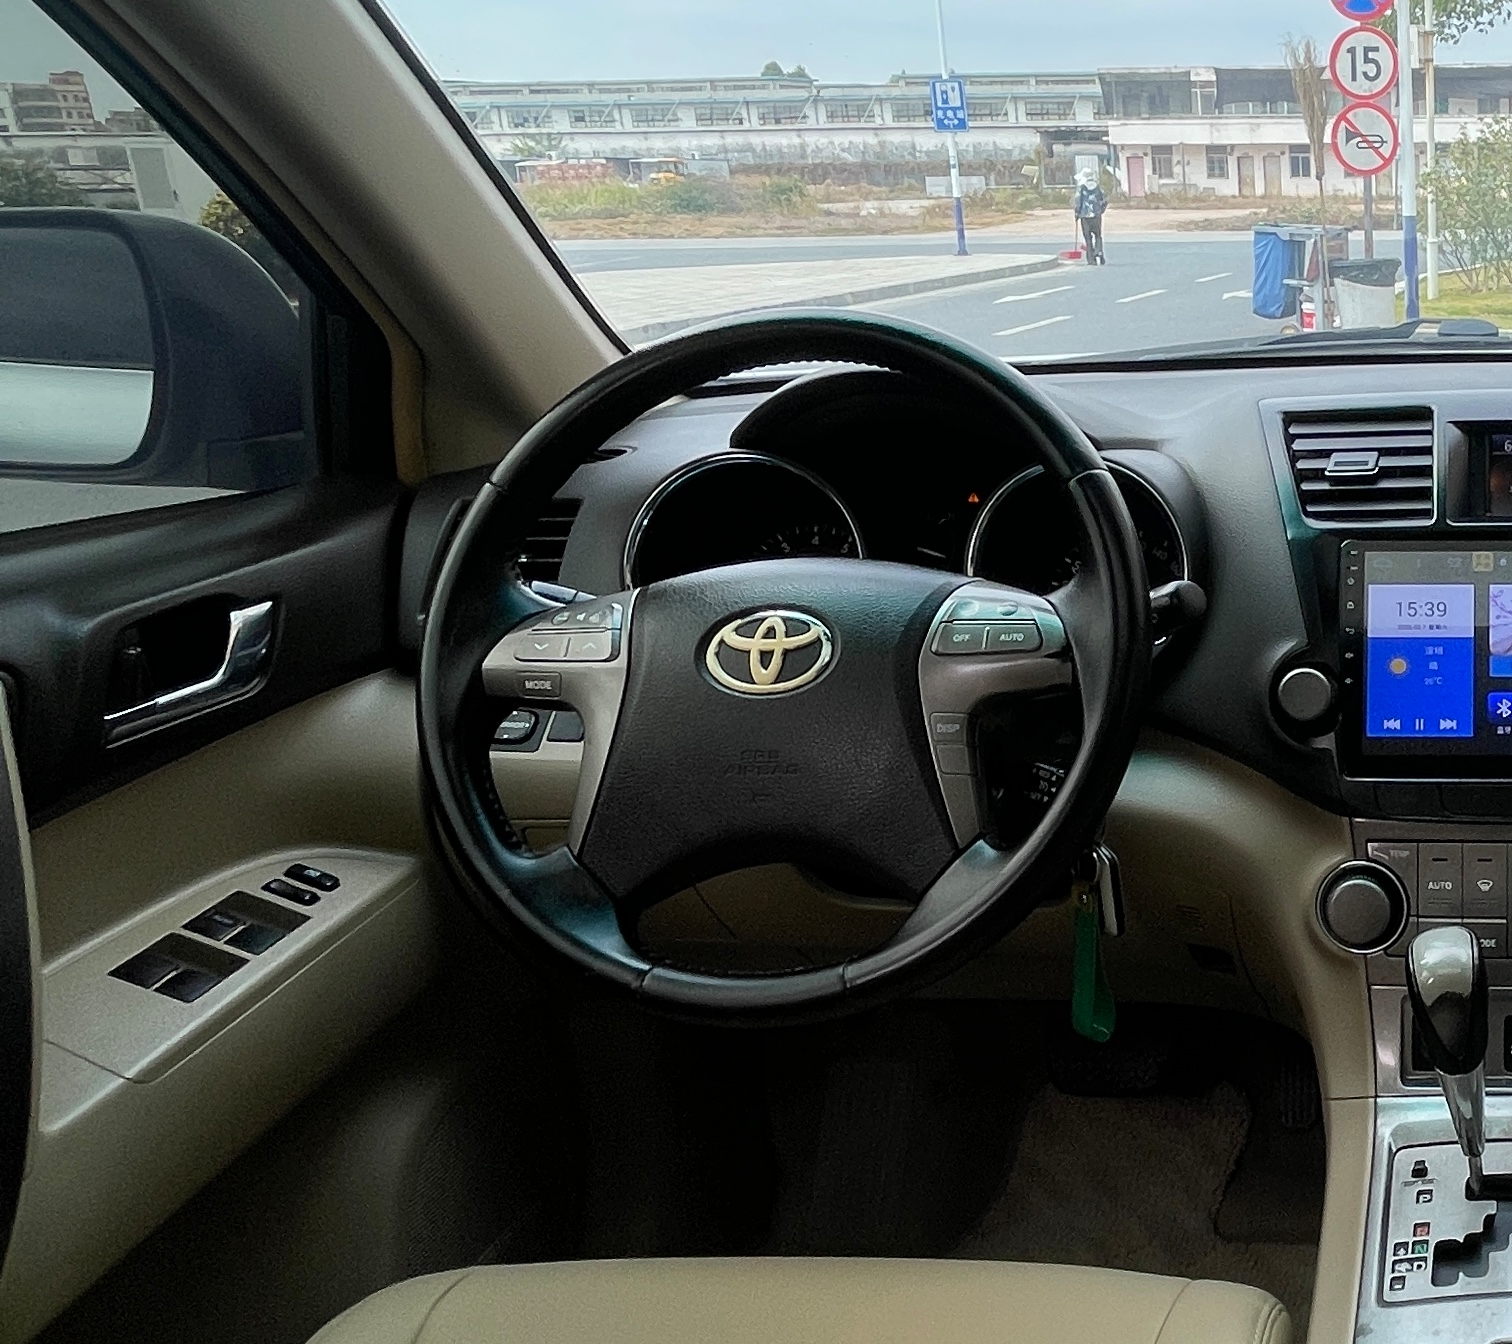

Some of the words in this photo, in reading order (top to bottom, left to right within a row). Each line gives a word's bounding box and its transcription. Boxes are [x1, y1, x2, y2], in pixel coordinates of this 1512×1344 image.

[1346, 46, 1382, 83] 15
[1396, 601, 1447, 617] 15:39
[953, 634, 971, 642] OFF
[1000, 633, 1025, 641] AUTO
[524, 679, 553, 690] MODE
[937, 723, 960, 733] DISP
[1428, 881, 1452, 890] AUTO
